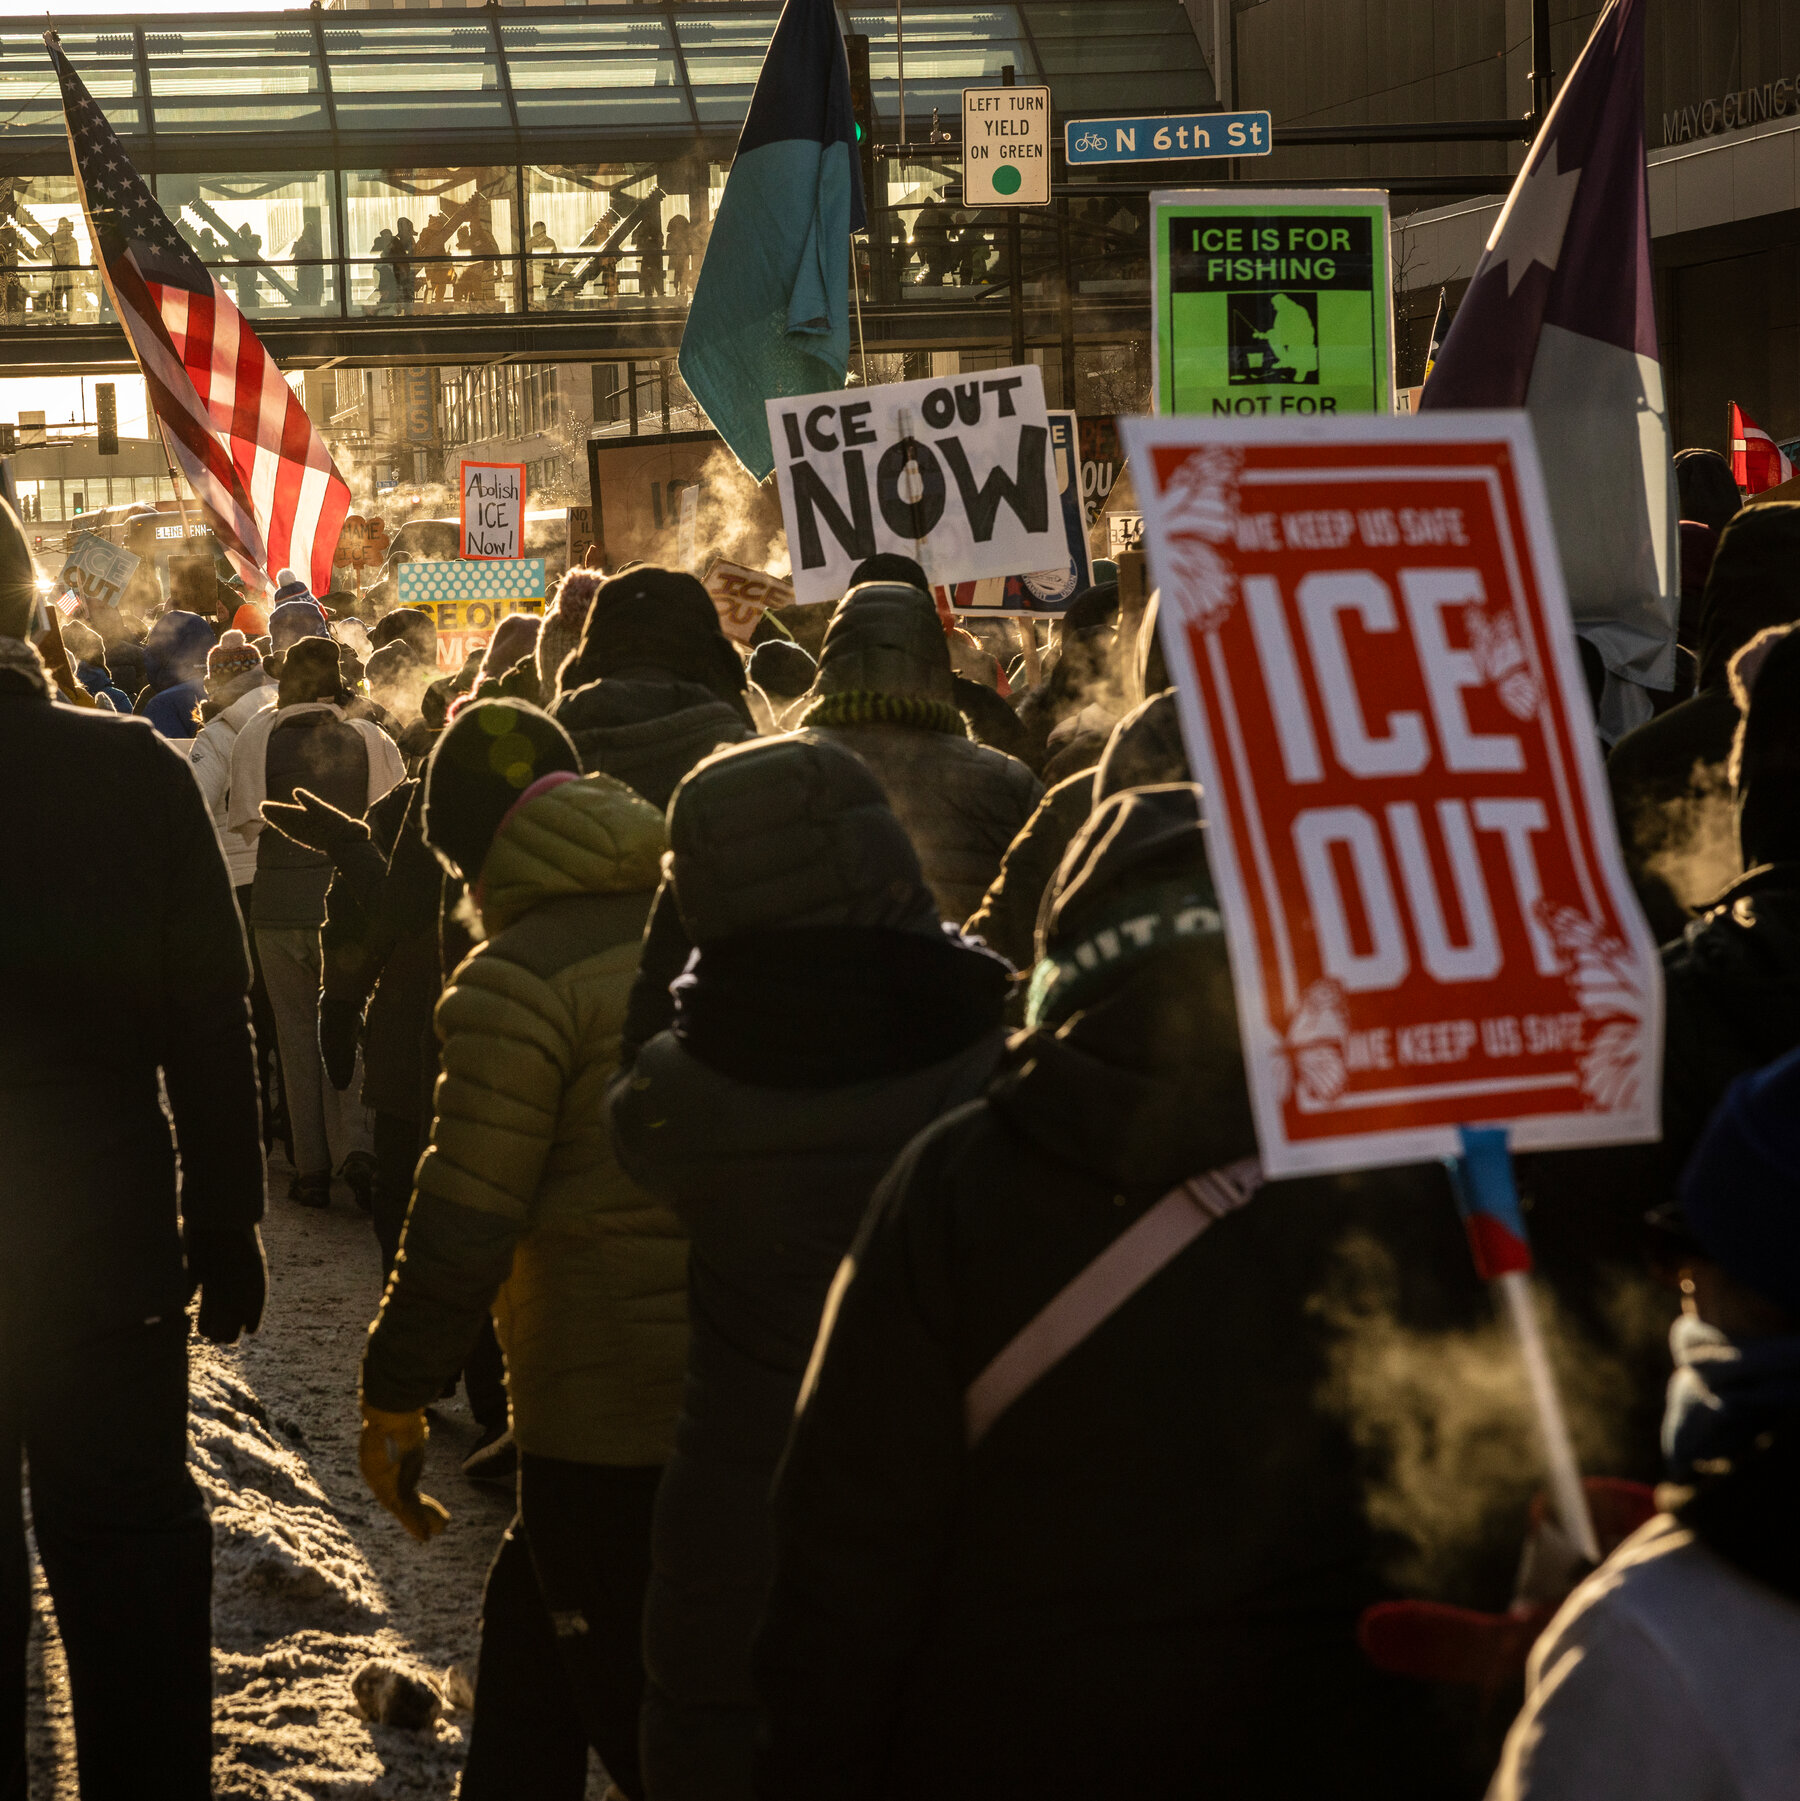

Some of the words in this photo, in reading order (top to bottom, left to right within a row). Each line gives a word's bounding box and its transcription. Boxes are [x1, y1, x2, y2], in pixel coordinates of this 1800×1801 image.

[969, 97, 1001, 111] LEFT
[1008, 96, 1044, 110] TURN
[1663, 101, 1715, 146] MAYO
[1722, 79, 1787, 128] CLINIC
[984, 119, 1030, 136] YIELD
[1116, 128, 1136, 152] N
[1153, 125, 1210, 150] 6th
[1227, 121, 1262, 147] St
[970, 145, 990, 159] ON
[999, 144, 1043, 158] GREEN
[1192, 228, 1243, 252] ICE
[1251, 228, 1281, 252] IS
[1288, 228, 1351, 251] FOR
[1207, 257, 1337, 282] FISHING
[782, 401, 877, 459] ICE
[921, 376, 1023, 430] OUT
[1212, 397, 1272, 416] NOT
[1281, 396, 1337, 416] FOR
[466, 472, 519, 500] Abolish
[789, 424, 1049, 570] NOW
[478, 502, 509, 528] ICE
[1283, 508, 1356, 549] KEEP
[1356, 508, 1398, 547] US
[1398, 508, 1470, 546] SAFE
[467, 530, 513, 558] Now!
[73, 540, 133, 589] ICE
[63, 565, 121, 601] OUT
[711, 572, 794, 609] ICE
[1242, 566, 1527, 785] ICE
[1290, 797, 1563, 993] OUT
[1396, 1019, 1478, 1067] KEEP
[1479, 1015, 1523, 1058] US
[1522, 1011, 1586, 1055] SAFE
